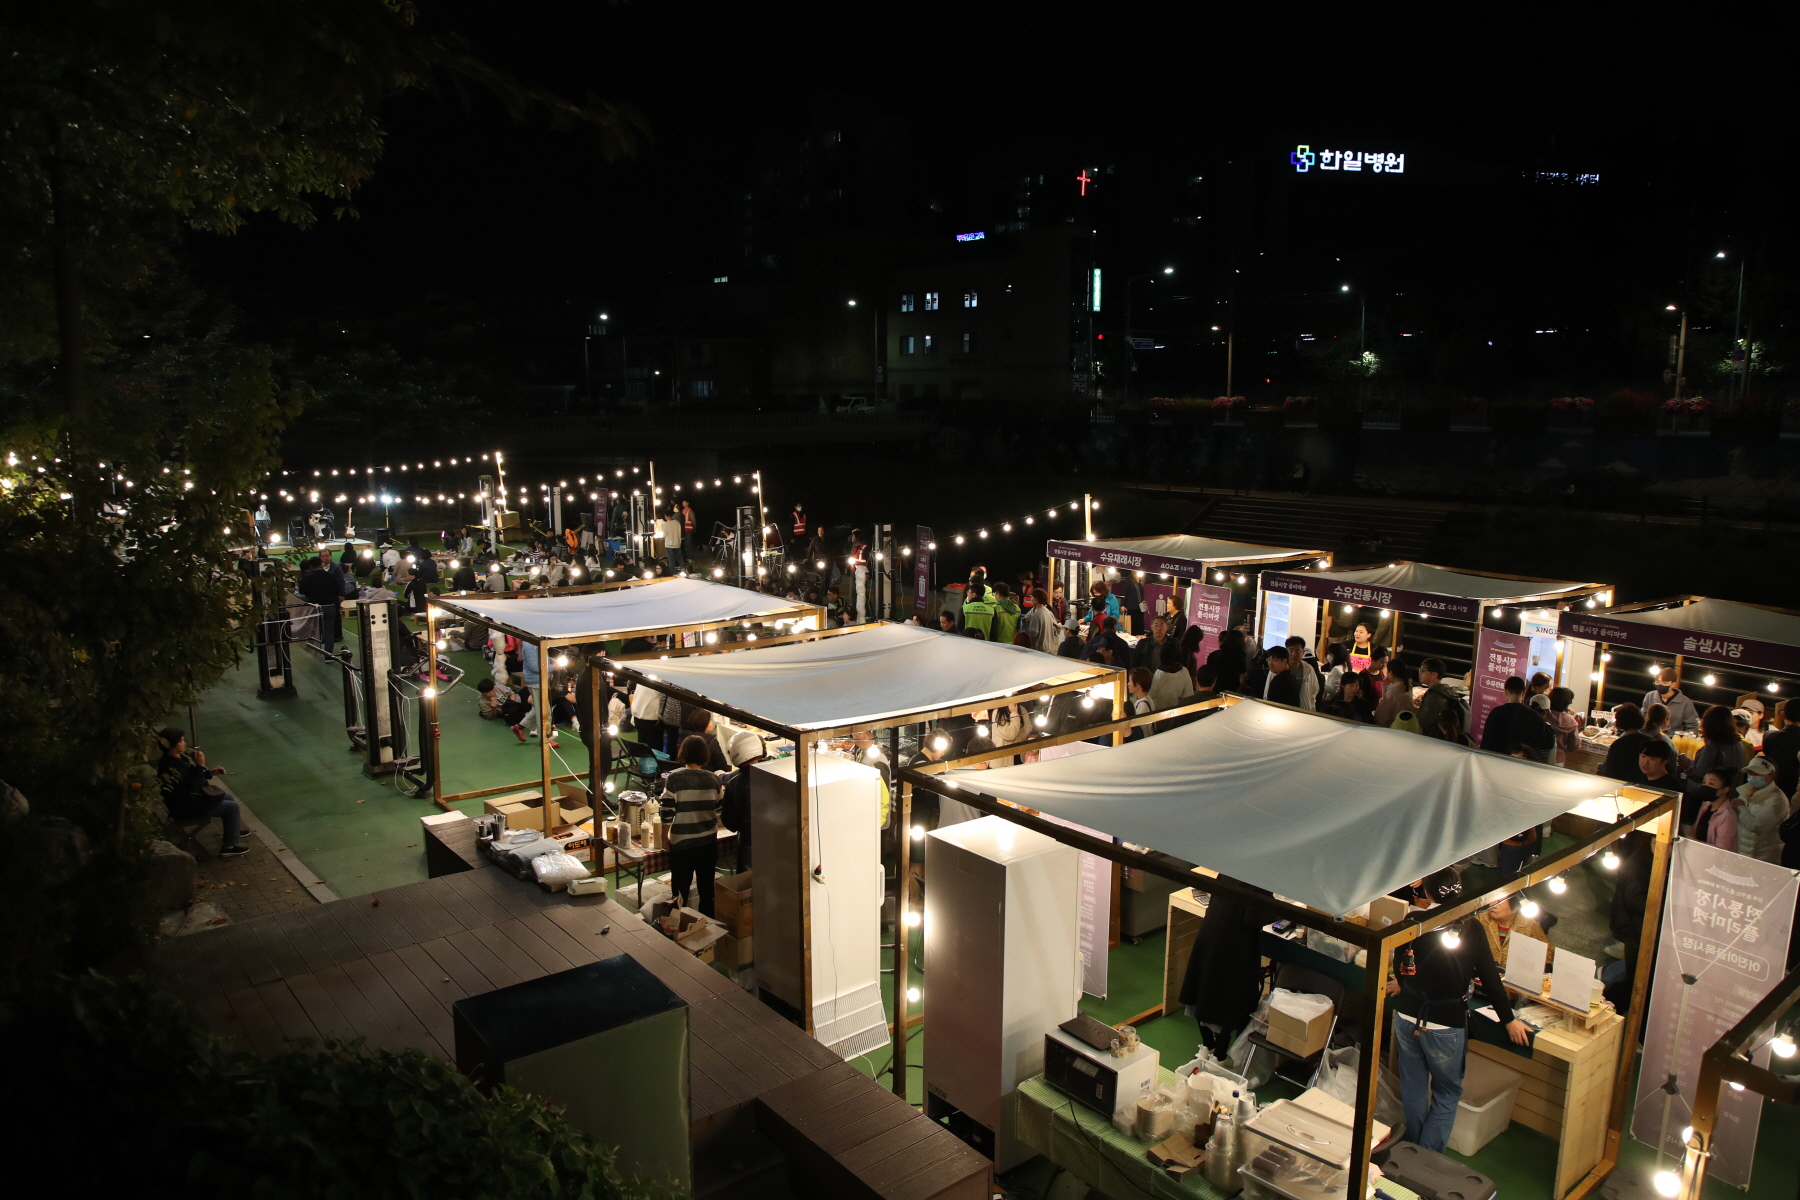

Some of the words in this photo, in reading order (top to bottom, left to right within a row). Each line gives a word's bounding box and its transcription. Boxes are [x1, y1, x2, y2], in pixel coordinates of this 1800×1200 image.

[1319, 149, 1405, 173] 한일병원
[1100, 551, 1142, 567] 수유재래시장
[1333, 585, 1393, 604] 수유전통시장
[1198, 602, 1221, 614] 전통시장
[1447, 604, 1468, 613] 수유시장
[1197, 610, 1219, 622] 플리마켓
[1572, 623, 1599, 636] 전통시장
[1600, 627, 1628, 640] 플리마켓
[1682, 635, 1745, 659] 솔샘시장
[1489, 653, 1517, 667] 전통시장
[1487, 662, 1516, 676] 플리마켓
